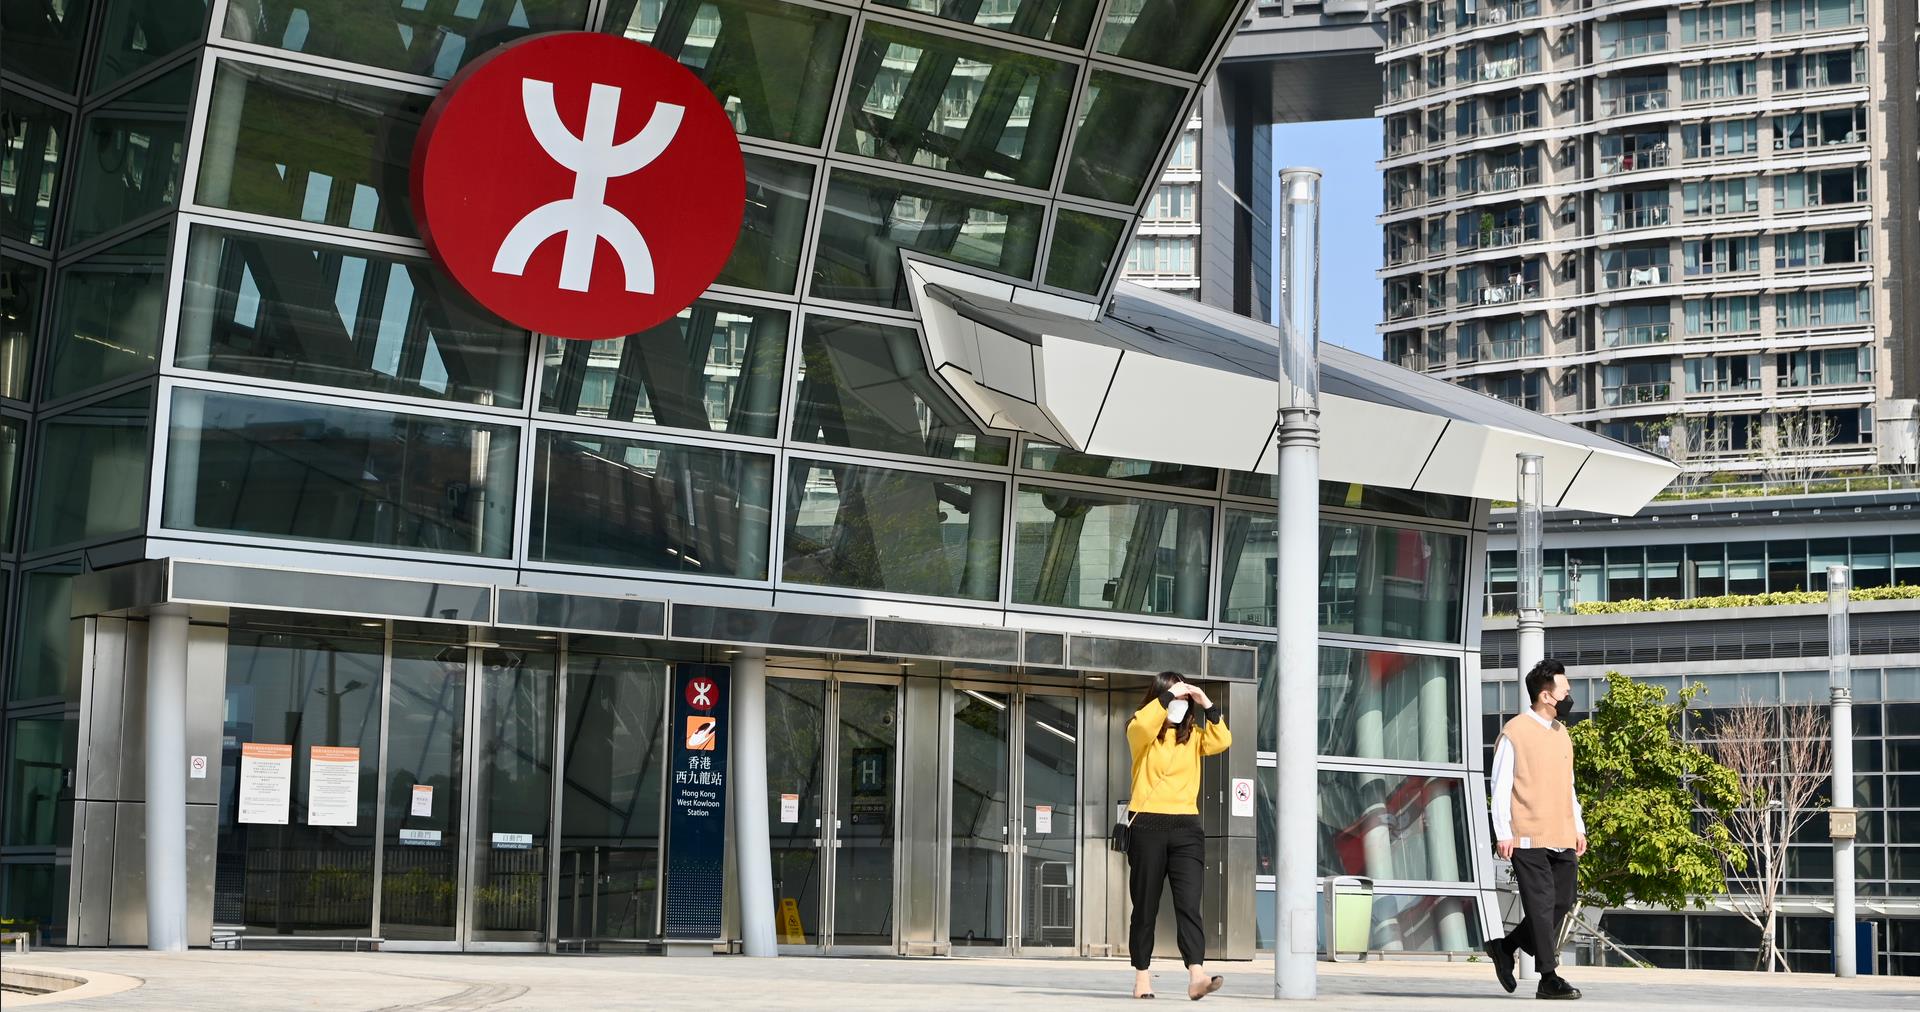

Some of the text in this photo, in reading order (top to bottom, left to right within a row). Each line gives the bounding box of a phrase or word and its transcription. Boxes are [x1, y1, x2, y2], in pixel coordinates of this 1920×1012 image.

[688, 756, 711, 770] 香港
[676, 771, 722, 785] 西九龍站
[863, 760, 876, 784] H
[681, 789, 716, 799] Hong Kong
